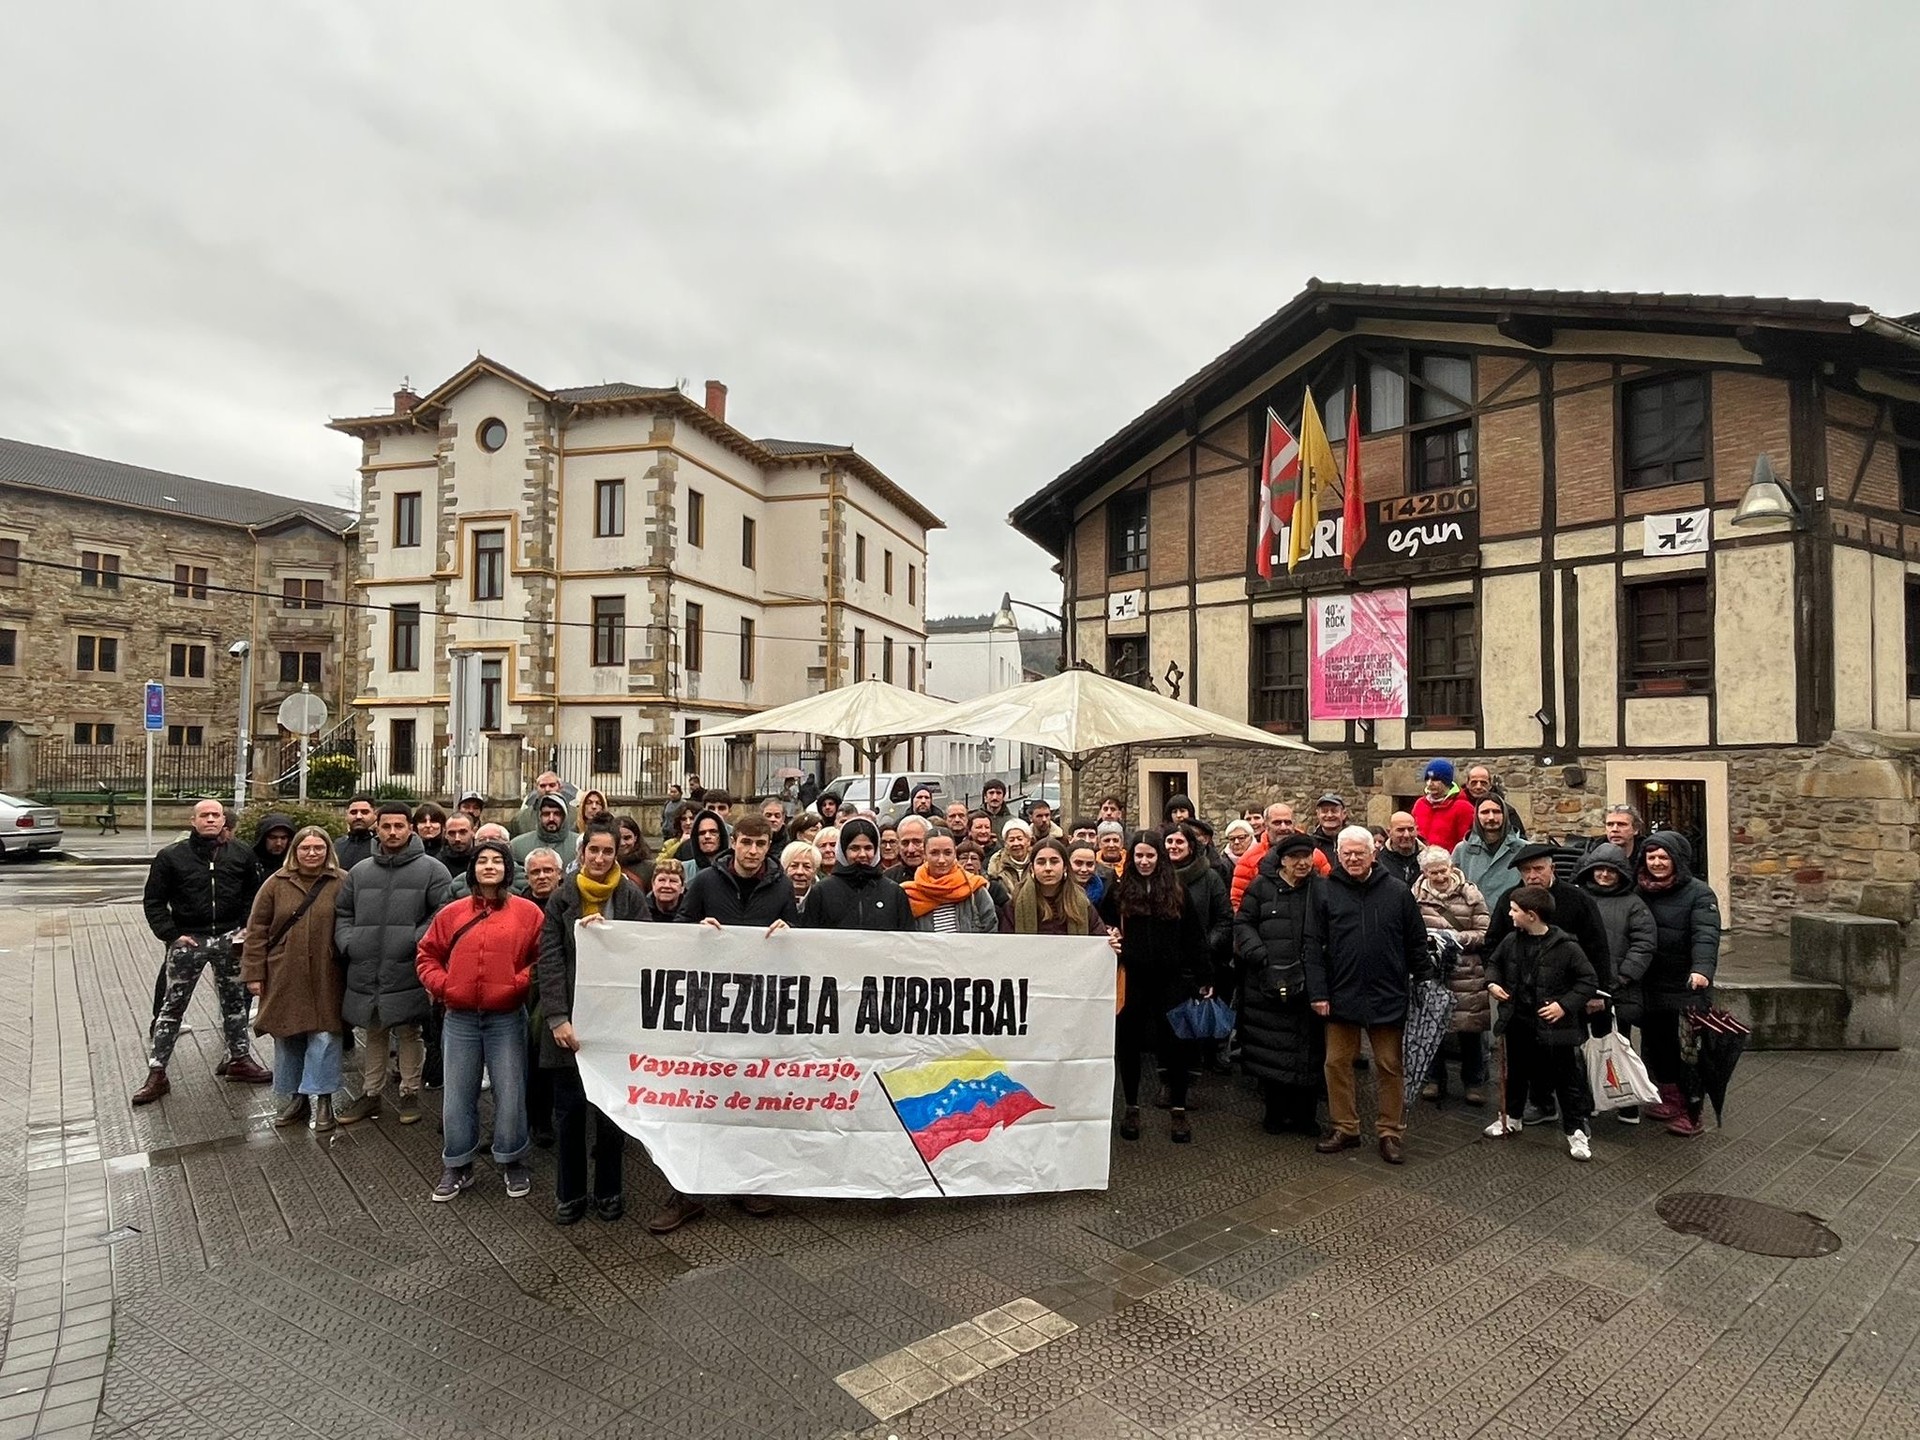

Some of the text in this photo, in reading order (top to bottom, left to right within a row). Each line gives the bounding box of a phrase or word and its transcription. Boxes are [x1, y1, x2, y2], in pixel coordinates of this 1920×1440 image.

[1383, 489, 1476, 520] 14200
[1387, 523, 1464, 557] egun
[1325, 615, 1345, 628] ROCK
[640, 968, 1029, 1036] VENEZUELA AURRERA!
[628, 1053, 861, 1082] Vayanse al carajo,
[627, 1085, 860, 1111] Yankis de mierda!
